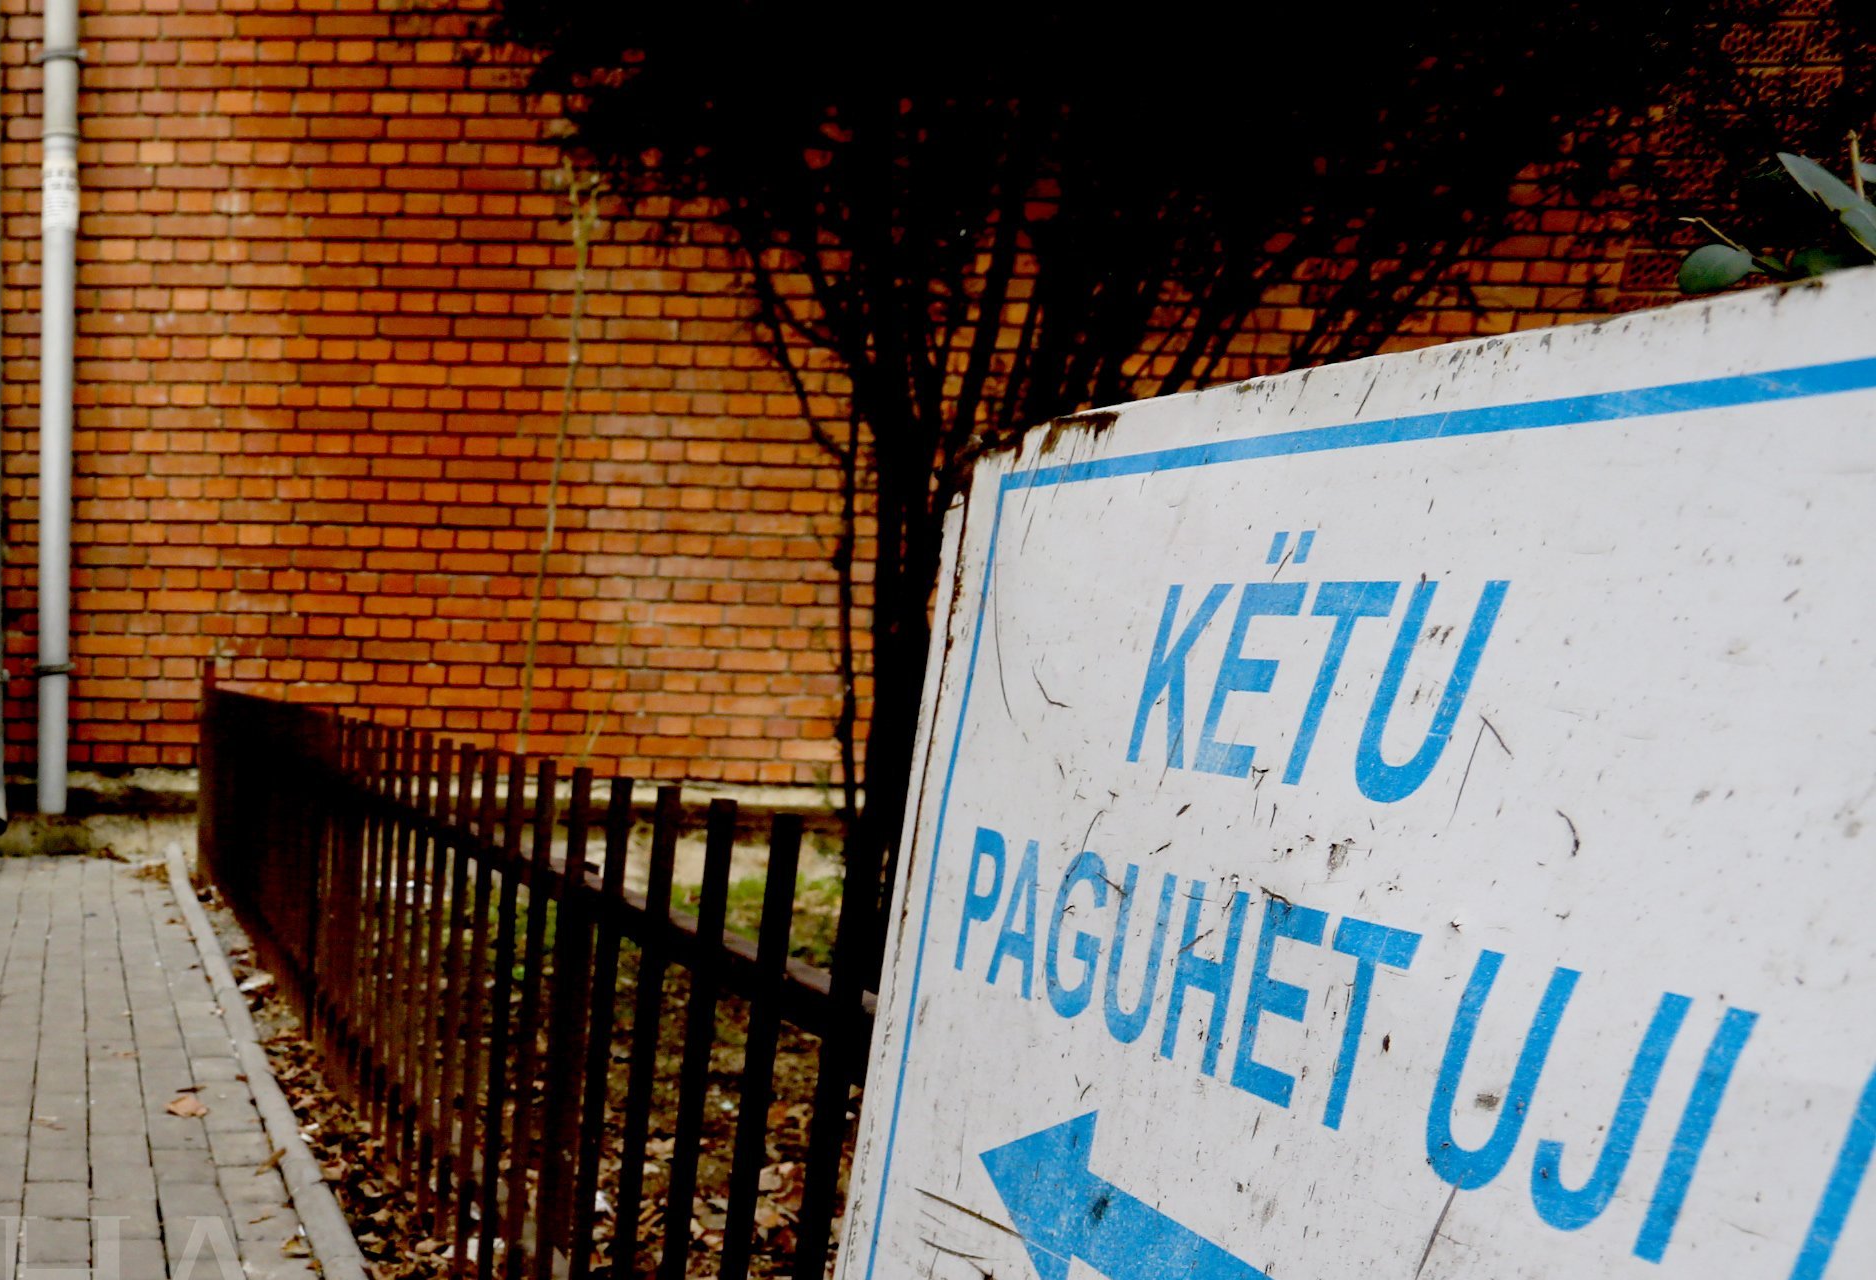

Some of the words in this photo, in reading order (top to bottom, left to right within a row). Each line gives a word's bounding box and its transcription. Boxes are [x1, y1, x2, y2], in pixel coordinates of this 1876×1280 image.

[1126, 530, 1511, 804] KËTU
[954, 826, 1423, 1132] PAGUHET
[1425, 949, 1761, 1265] UJI
